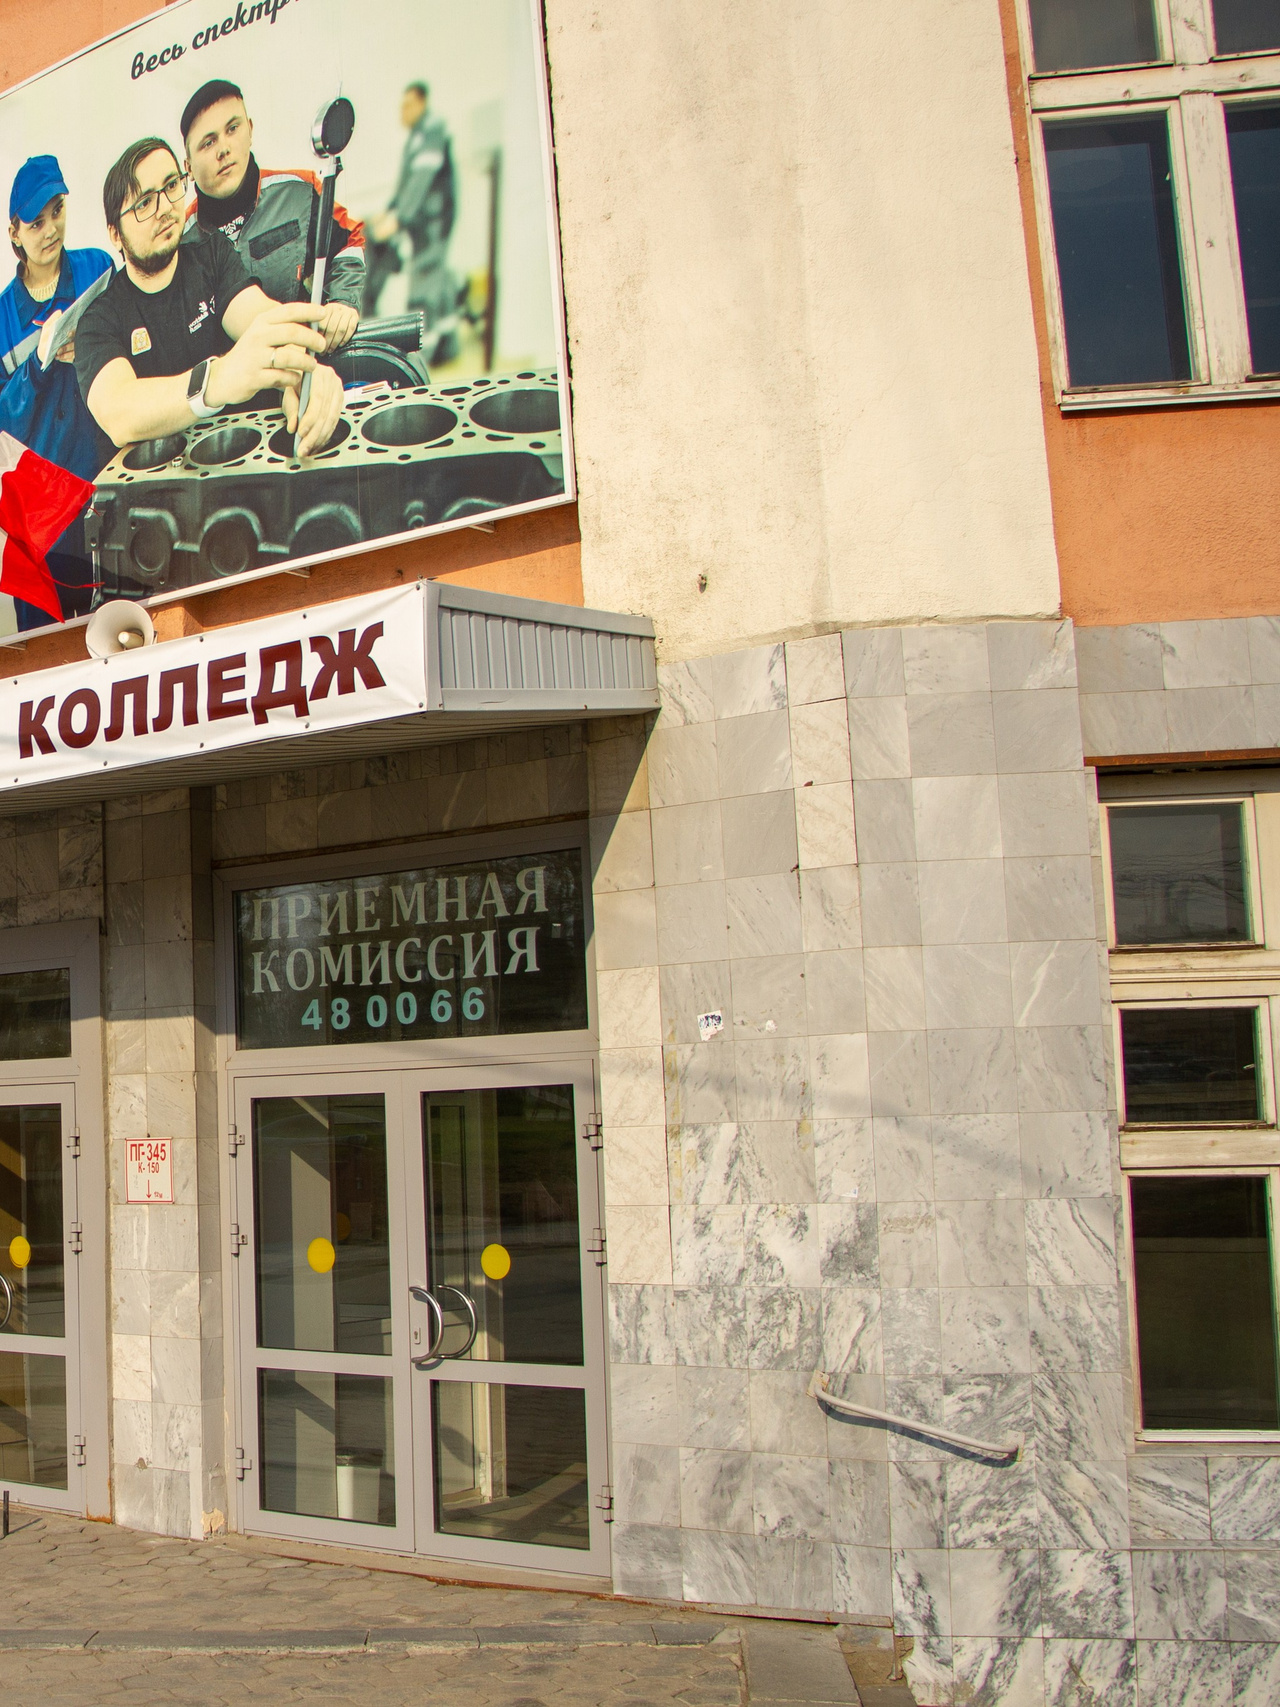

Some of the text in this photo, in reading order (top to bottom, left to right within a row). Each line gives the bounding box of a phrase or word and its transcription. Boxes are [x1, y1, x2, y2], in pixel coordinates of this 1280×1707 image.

[131, 0, 300, 80] весь спектр
[19, 620, 387, 760] КОЛЛЕДЖ
[251, 866, 549, 941] ПРИЕМНАЯ
[251, 926, 542, 994] КОМИССИЯ
[130, 1143, 167, 1161] ПГ-345
